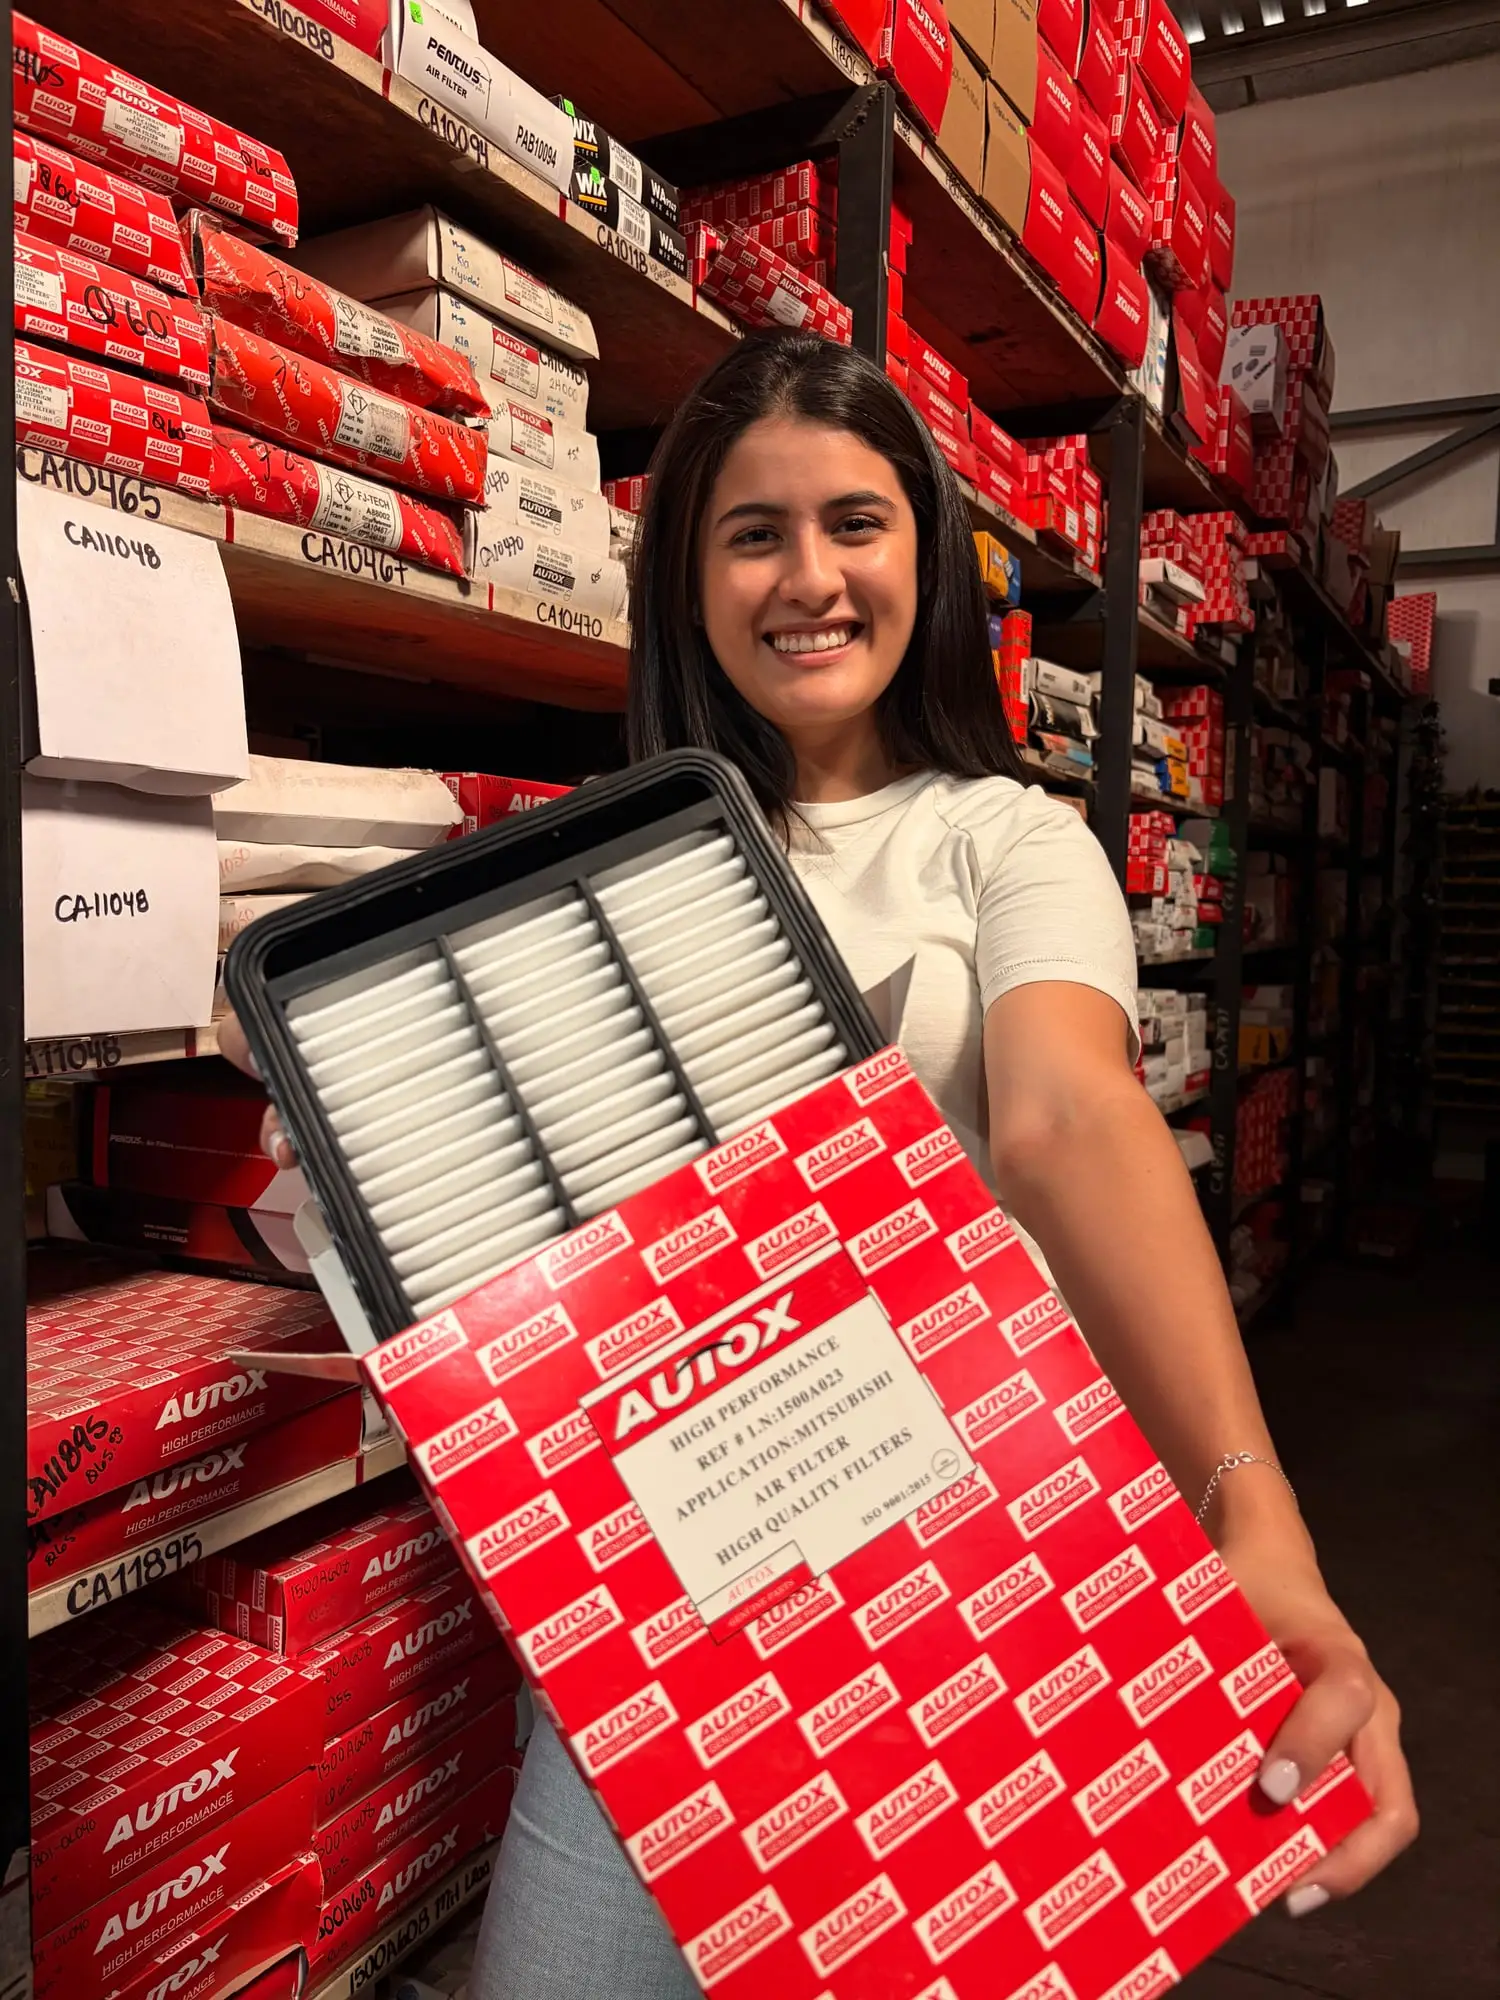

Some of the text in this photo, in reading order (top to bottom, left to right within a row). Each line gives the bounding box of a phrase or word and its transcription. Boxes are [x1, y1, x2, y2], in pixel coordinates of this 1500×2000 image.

[427, 37, 481, 84] PENTIUS
[1096, 28, 1113, 64] AUTOX
[1158, 20, 1184, 64] AUTOX
[37, 93, 73, 113] AUTOX
[111, 86, 160, 115] AUTOX
[425, 64, 468, 99] AIR FILTER
[1046, 76, 1071, 112] AUTOX
[418, 98, 489, 170] CA10094
[569, 116, 597, 145] WIX
[1137, 98, 1158, 142] AUTOX
[1192, 120, 1212, 156] AUTOX
[187, 157, 214, 173] AUTOX
[515, 125, 558, 168] PAB10094
[248, 184, 273, 199] AUTOX
[575, 172, 608, 198] WIX
[1040, 188, 1063, 221] AUTOX
[1120, 189, 1145, 225] AUTOX
[117, 227, 149, 244] AUTOX
[1184, 200, 1204, 236] AUTOX
[72, 238, 108, 256] AUTOX
[597, 224, 648, 274] CA10118
[780, 278, 805, 299] AUTOX
[1114, 292, 1141, 325] AUTOX
[29, 318, 66, 335] AUTOX
[495, 333, 528, 355] AUTOX
[72, 366, 105, 380] AUTOX
[109, 344, 142, 361] AUTOX
[923, 349, 951, 382] AUTOX
[74, 418, 109, 434] AUTOX
[114, 403, 146, 417] AUTOX
[512, 407, 542, 428] AUTOX
[928, 391, 953, 420] AUTOX
[149, 440, 181, 455] AUTOX
[990, 425, 1012, 450] AUTOX
[16, 446, 160, 519] CA10465
[229, 448, 259, 487] FJ-TECH
[357, 491, 390, 510] FJ-TECH
[521, 500, 552, 517] AUTOX
[65, 520, 161, 570] CA11048
[302, 532, 408, 585] CA10467
[535, 568, 565, 584] AUTOX
[537, 602, 602, 637] CA10470
[54, 889, 150, 923] CA11048
[25, 1036, 122, 1075] A11048
[808, 1124, 867, 1171] AUTOX
[654, 1213, 717, 1264] AUTOX
[862, 1206, 919, 1251] AUTOX
[915, 1290, 972, 1337] AUTOX
[615, 1291, 802, 1440] AUTOX
[155, 1369, 268, 1431] AUTOX
[669, 1335, 841, 1452] HIGH PERFORMANCE
[968, 1376, 1025, 1426] AUTOX
[161, 1402, 266, 1454] HIGH PERFORMANCE
[434, 1406, 497, 1458] AUTOX
[440, 1423, 506, 1470] GENUINE PARTS
[675, 1370, 894, 1522] APPLICATION:MITSUBISHI
[696, 1441, 730, 1471] REF
[734, 1433, 745, 1446] #
[753, 1435, 851, 1507] AIR FILTER
[121, 1443, 249, 1514] AUTOX
[715, 1427, 913, 1566] HIGH QUALITY FILTERS
[861, 1473, 932, 1526] ISO 9001:2015
[1020, 1464, 1081, 1518] AUTOX
[126, 1480, 240, 1535] HIGH PERFORMANCE
[485, 1498, 550, 1551] AUTOX
[1028, 1481, 1090, 1528] GENUINE PARTS
[361, 1526, 450, 1584] AUTOX
[492, 1514, 558, 1563] GENUINE PARTS
[67, 1532, 203, 1615] CA11895
[365, 1584, 387, 1600] HIGH
[727, 1564, 775, 1604] AUTOX
[972, 1561, 1034, 1618] AUTOX
[1076, 1553, 1135, 1609] AUTOX
[383, 1597, 473, 1670] AUTOX
[537, 1593, 602, 1647] AUTOX
[389, 1669, 411, 1687] HIGH
[922, 1663, 985, 1722] AUTOX
[1132, 1645, 1192, 1703] AUTOX
[381, 1677, 470, 1753] AUTOX
[591, 1689, 657, 1747] AUTOX
[701, 1682, 769, 1744] AUTOX
[103, 1747, 241, 1854] AUTOX
[372, 1750, 463, 1834] AUTOX
[758, 1781, 826, 1845] AUTOX
[981, 1759, 1044, 1822] AUTOX
[111, 1850, 142, 1874] HIGH
[145, 1791, 233, 1853] PERFORMANCE
[375, 1824, 459, 1912] AUTOX
[1146, 1847, 1206, 1911] AUTOX
[93, 1842, 231, 1956] AUTOX
[928, 1872, 994, 1938] AUTOX
[102, 1949, 133, 1976] HIGH
[135, 1886, 225, 1954] PERFORMANCE
